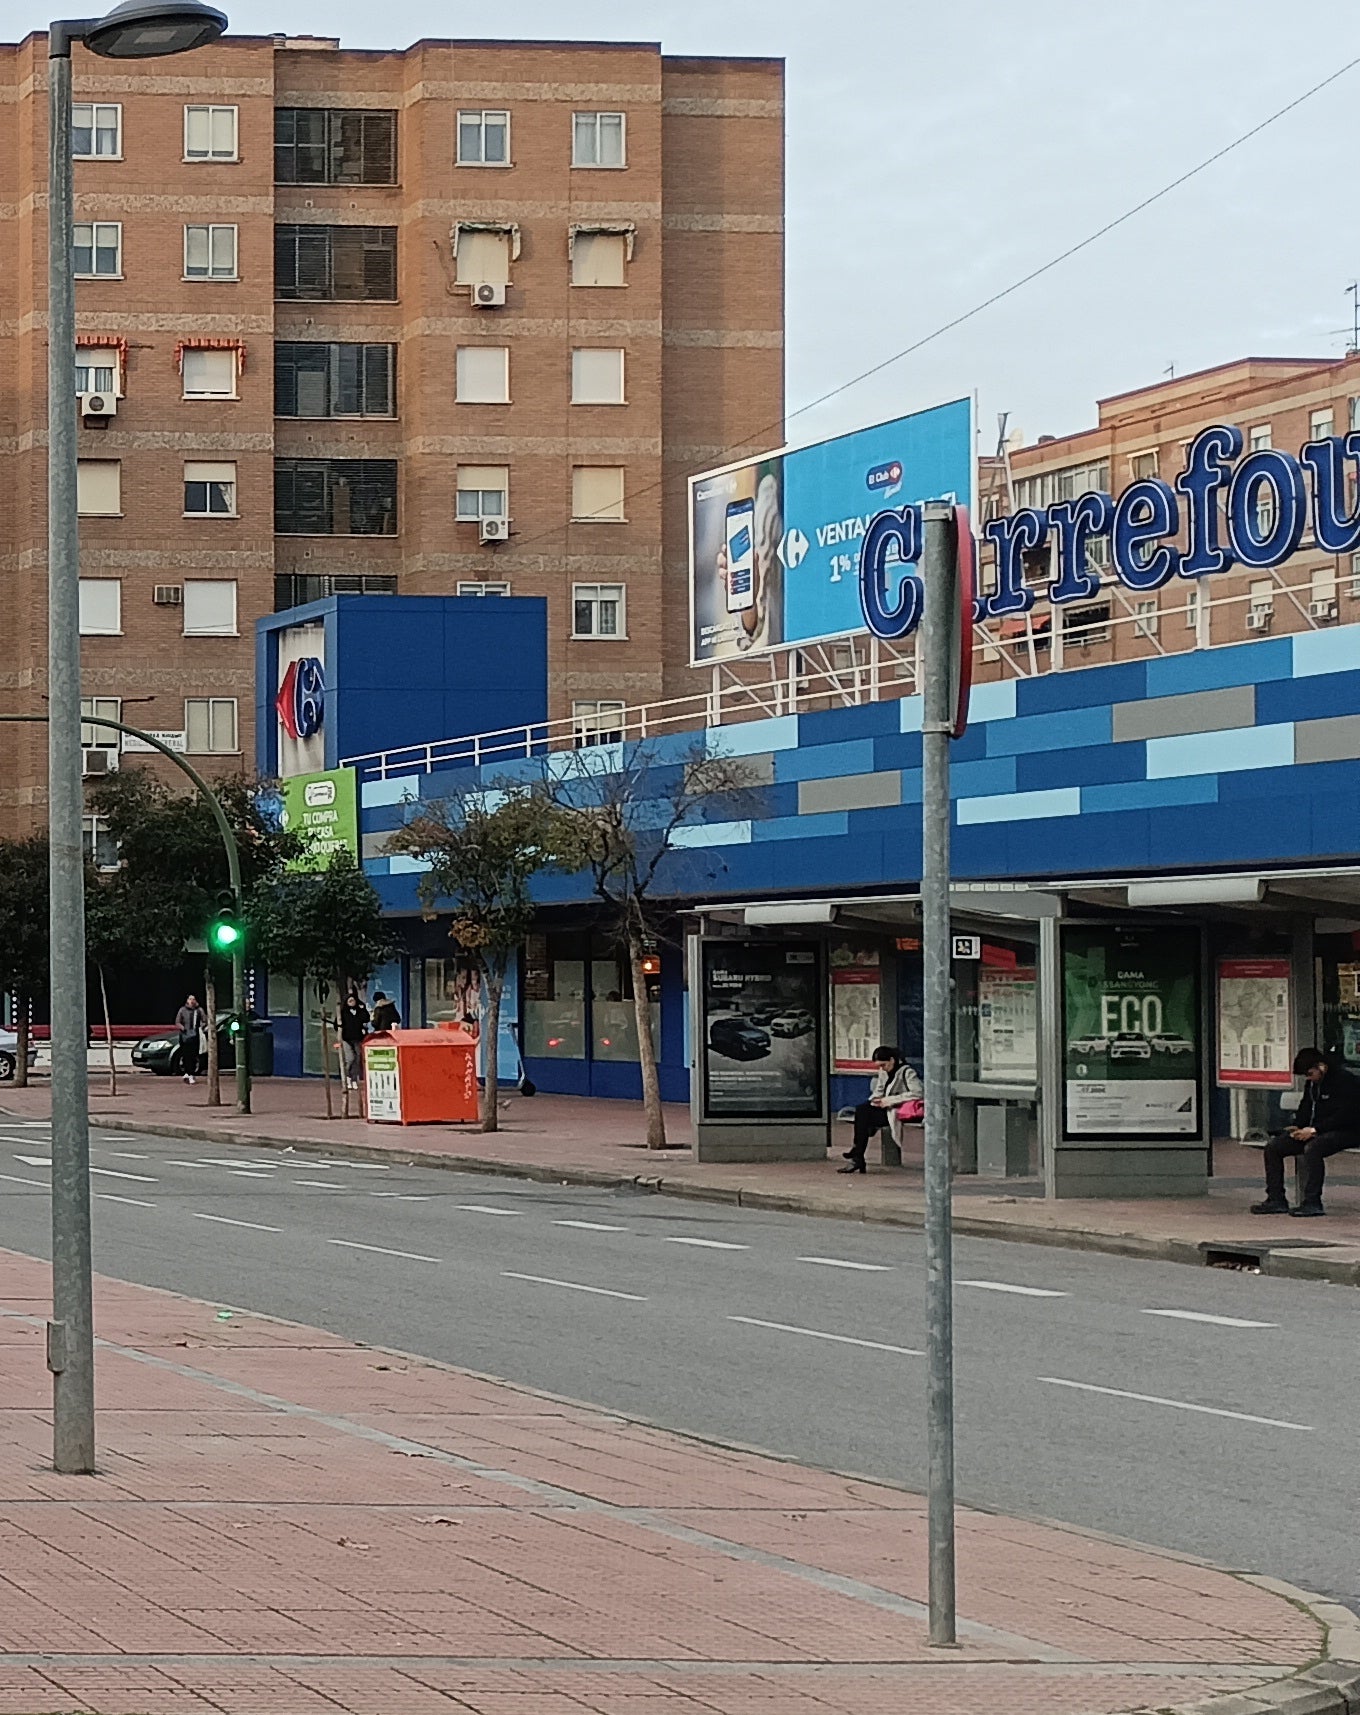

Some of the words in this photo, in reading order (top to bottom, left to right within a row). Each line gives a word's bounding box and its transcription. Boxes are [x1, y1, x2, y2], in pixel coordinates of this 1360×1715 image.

[859, 424, 1360, 640] Crrefou
[303, 812, 312, 826] TU
[1101, 994, 1162, 1038] ECO
